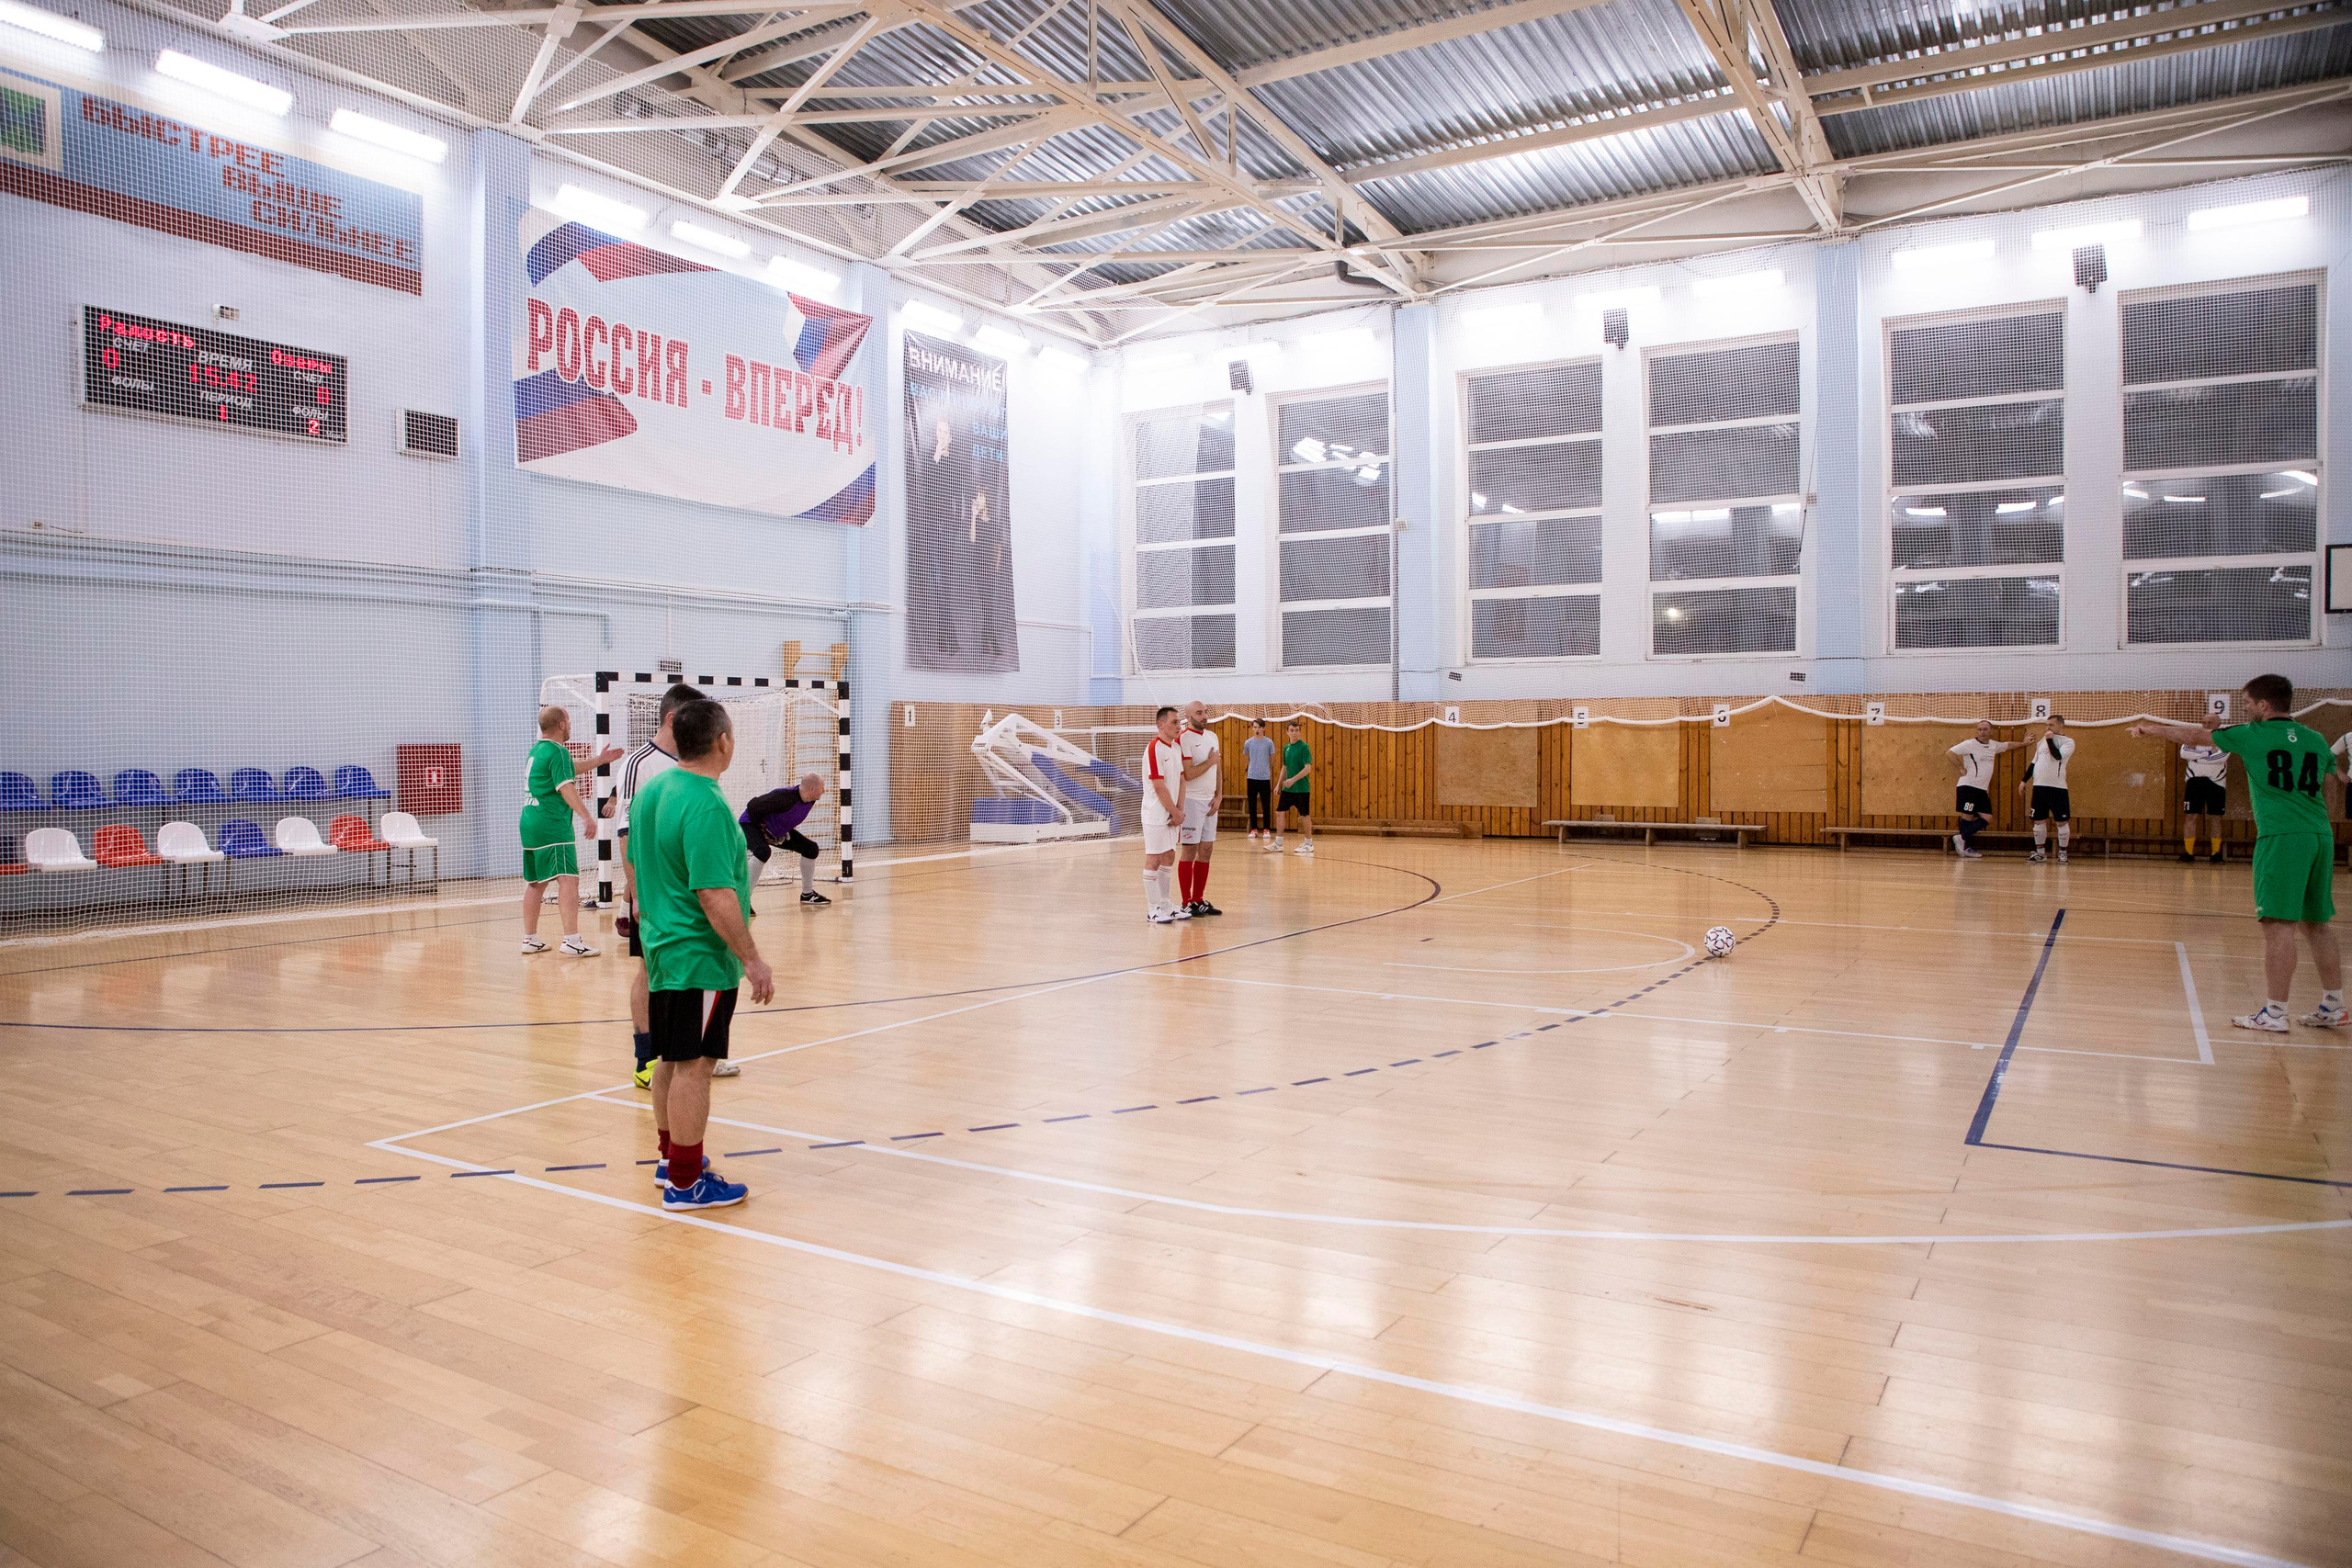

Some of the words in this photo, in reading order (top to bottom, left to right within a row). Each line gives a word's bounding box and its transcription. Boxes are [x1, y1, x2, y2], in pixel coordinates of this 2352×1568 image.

[82, 95, 285, 178] БЫСТРЕЕ
[222, 164, 343, 220] ВЫШЕ
[252, 199, 416, 265] СИЛЬНЕЕ
[99, 315, 195, 349] Радость
[103, 349, 119, 368] 0
[198, 351, 253, 371] ВРЕМЯ
[294, 371, 324, 384] СЧЕТ
[527, 298, 688, 408] РОССИЯ
[725, 353, 863, 455] ВПЕРЕД!
[199, 390, 253, 410] ПЕРИОД
[316, 386, 329, 404] 0
[220, 405, 227, 421] 1
[308, 419, 319, 434] 2
[1871, 707, 1880, 721] 7
[2214, 700, 2224, 715] 9
[1448, 712, 1456, 723] 4
[2267, 749, 2321, 797] 84
[1963, 802, 1974, 812] 80
